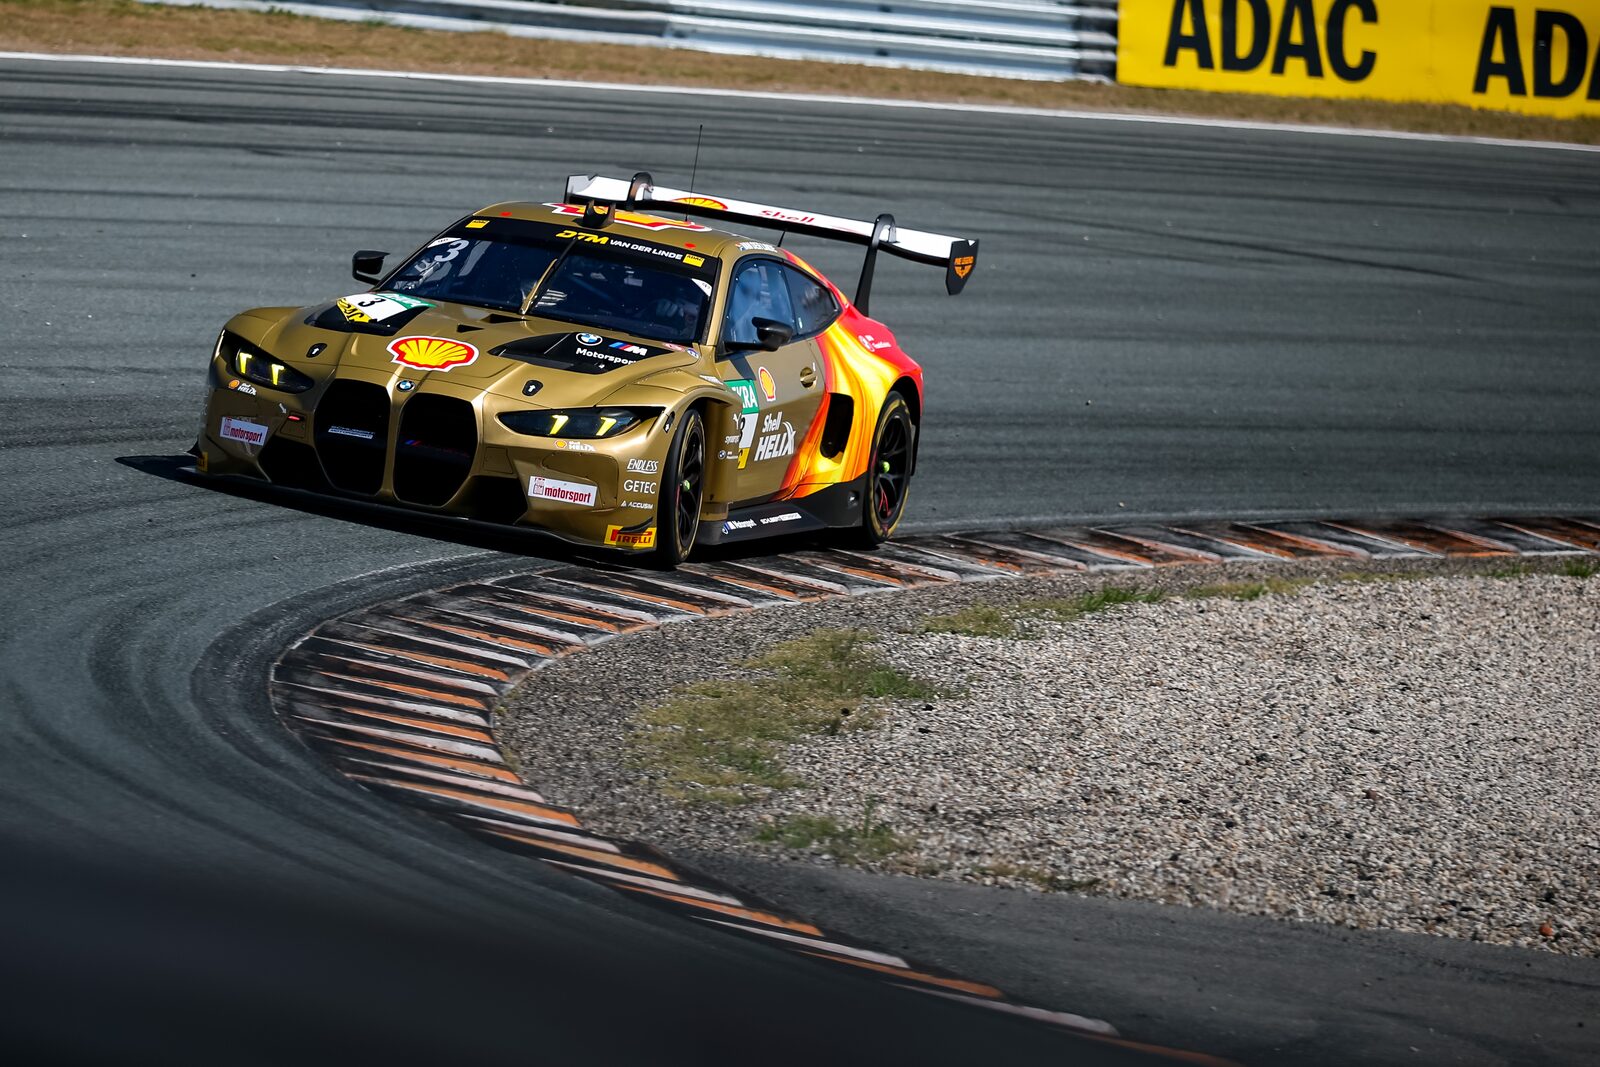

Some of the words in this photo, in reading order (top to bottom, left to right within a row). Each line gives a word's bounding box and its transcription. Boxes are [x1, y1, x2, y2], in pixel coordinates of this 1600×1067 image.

[1164, 0, 1378, 82] ADAC
[1473, 6, 1600, 101] AD
[760, 210, 815, 223] Shell
[434, 239, 470, 262] 3
[556, 230, 609, 245] DTM
[610, 239, 631, 249] VAN
[631, 243, 652, 253] DER
[652, 248, 683, 260] LINDE
[358, 298, 386, 308] 3
[762, 411, 783, 433] Shell
[230, 427, 263, 443] motorsport
[754, 421, 797, 462] HELIX
[568, 443, 596, 452] HELIX
[627, 458, 659, 472] ENDLESS
[624, 479, 657, 494] GETEC
[544, 487, 592, 504] motorsport
[610, 529, 653, 544] PIRELLI
